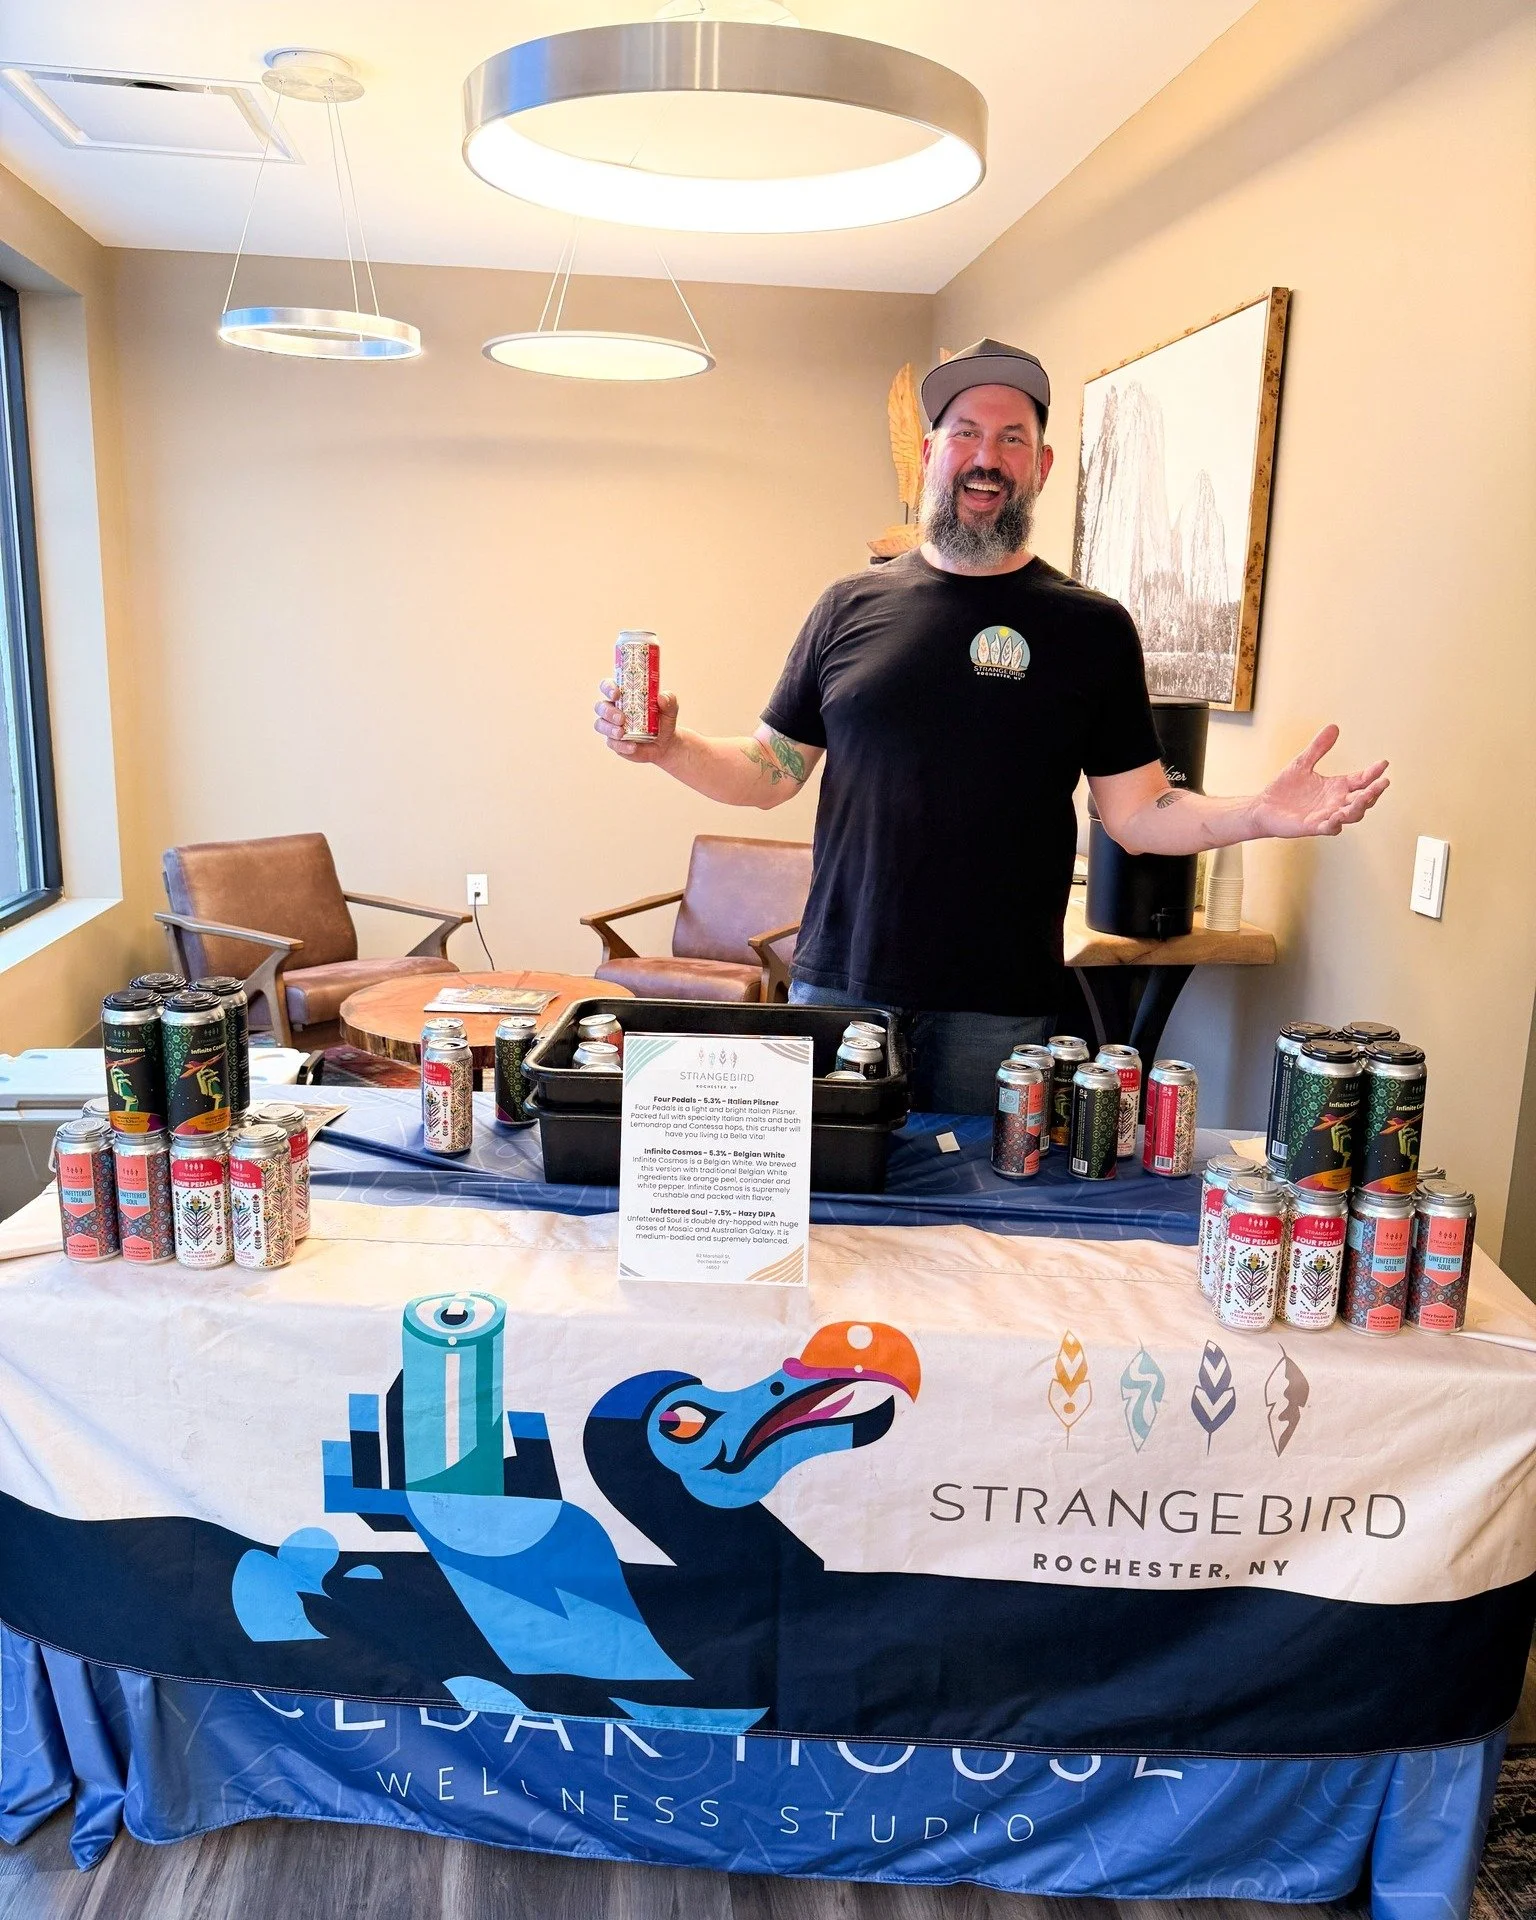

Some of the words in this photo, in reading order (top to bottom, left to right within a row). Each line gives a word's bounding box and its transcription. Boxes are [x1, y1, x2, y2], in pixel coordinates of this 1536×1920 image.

[1165, 765, 1187, 781] ater
[680, 1071, 754, 1082] STRANGEBIRD
[190, 1179, 218, 1188] PEDALS
[1208, 1207, 1221, 1216] FOU
[1231, 1233, 1251, 1243] FOUR
[1252, 1238, 1278, 1246] PEDALS
[1296, 1235, 1317, 1246] FOUR
[1318, 1239, 1342, 1247] PEDALS
[1428, 1255, 1460, 1264] UNFETTERED
[929, 1483, 1407, 1540] STRANGEBIRD
[1033, 1553, 1231, 1580] ROCHESTER,
[1248, 1559, 1290, 1576] NY
[780, 1806, 1034, 1843] STUDIO
